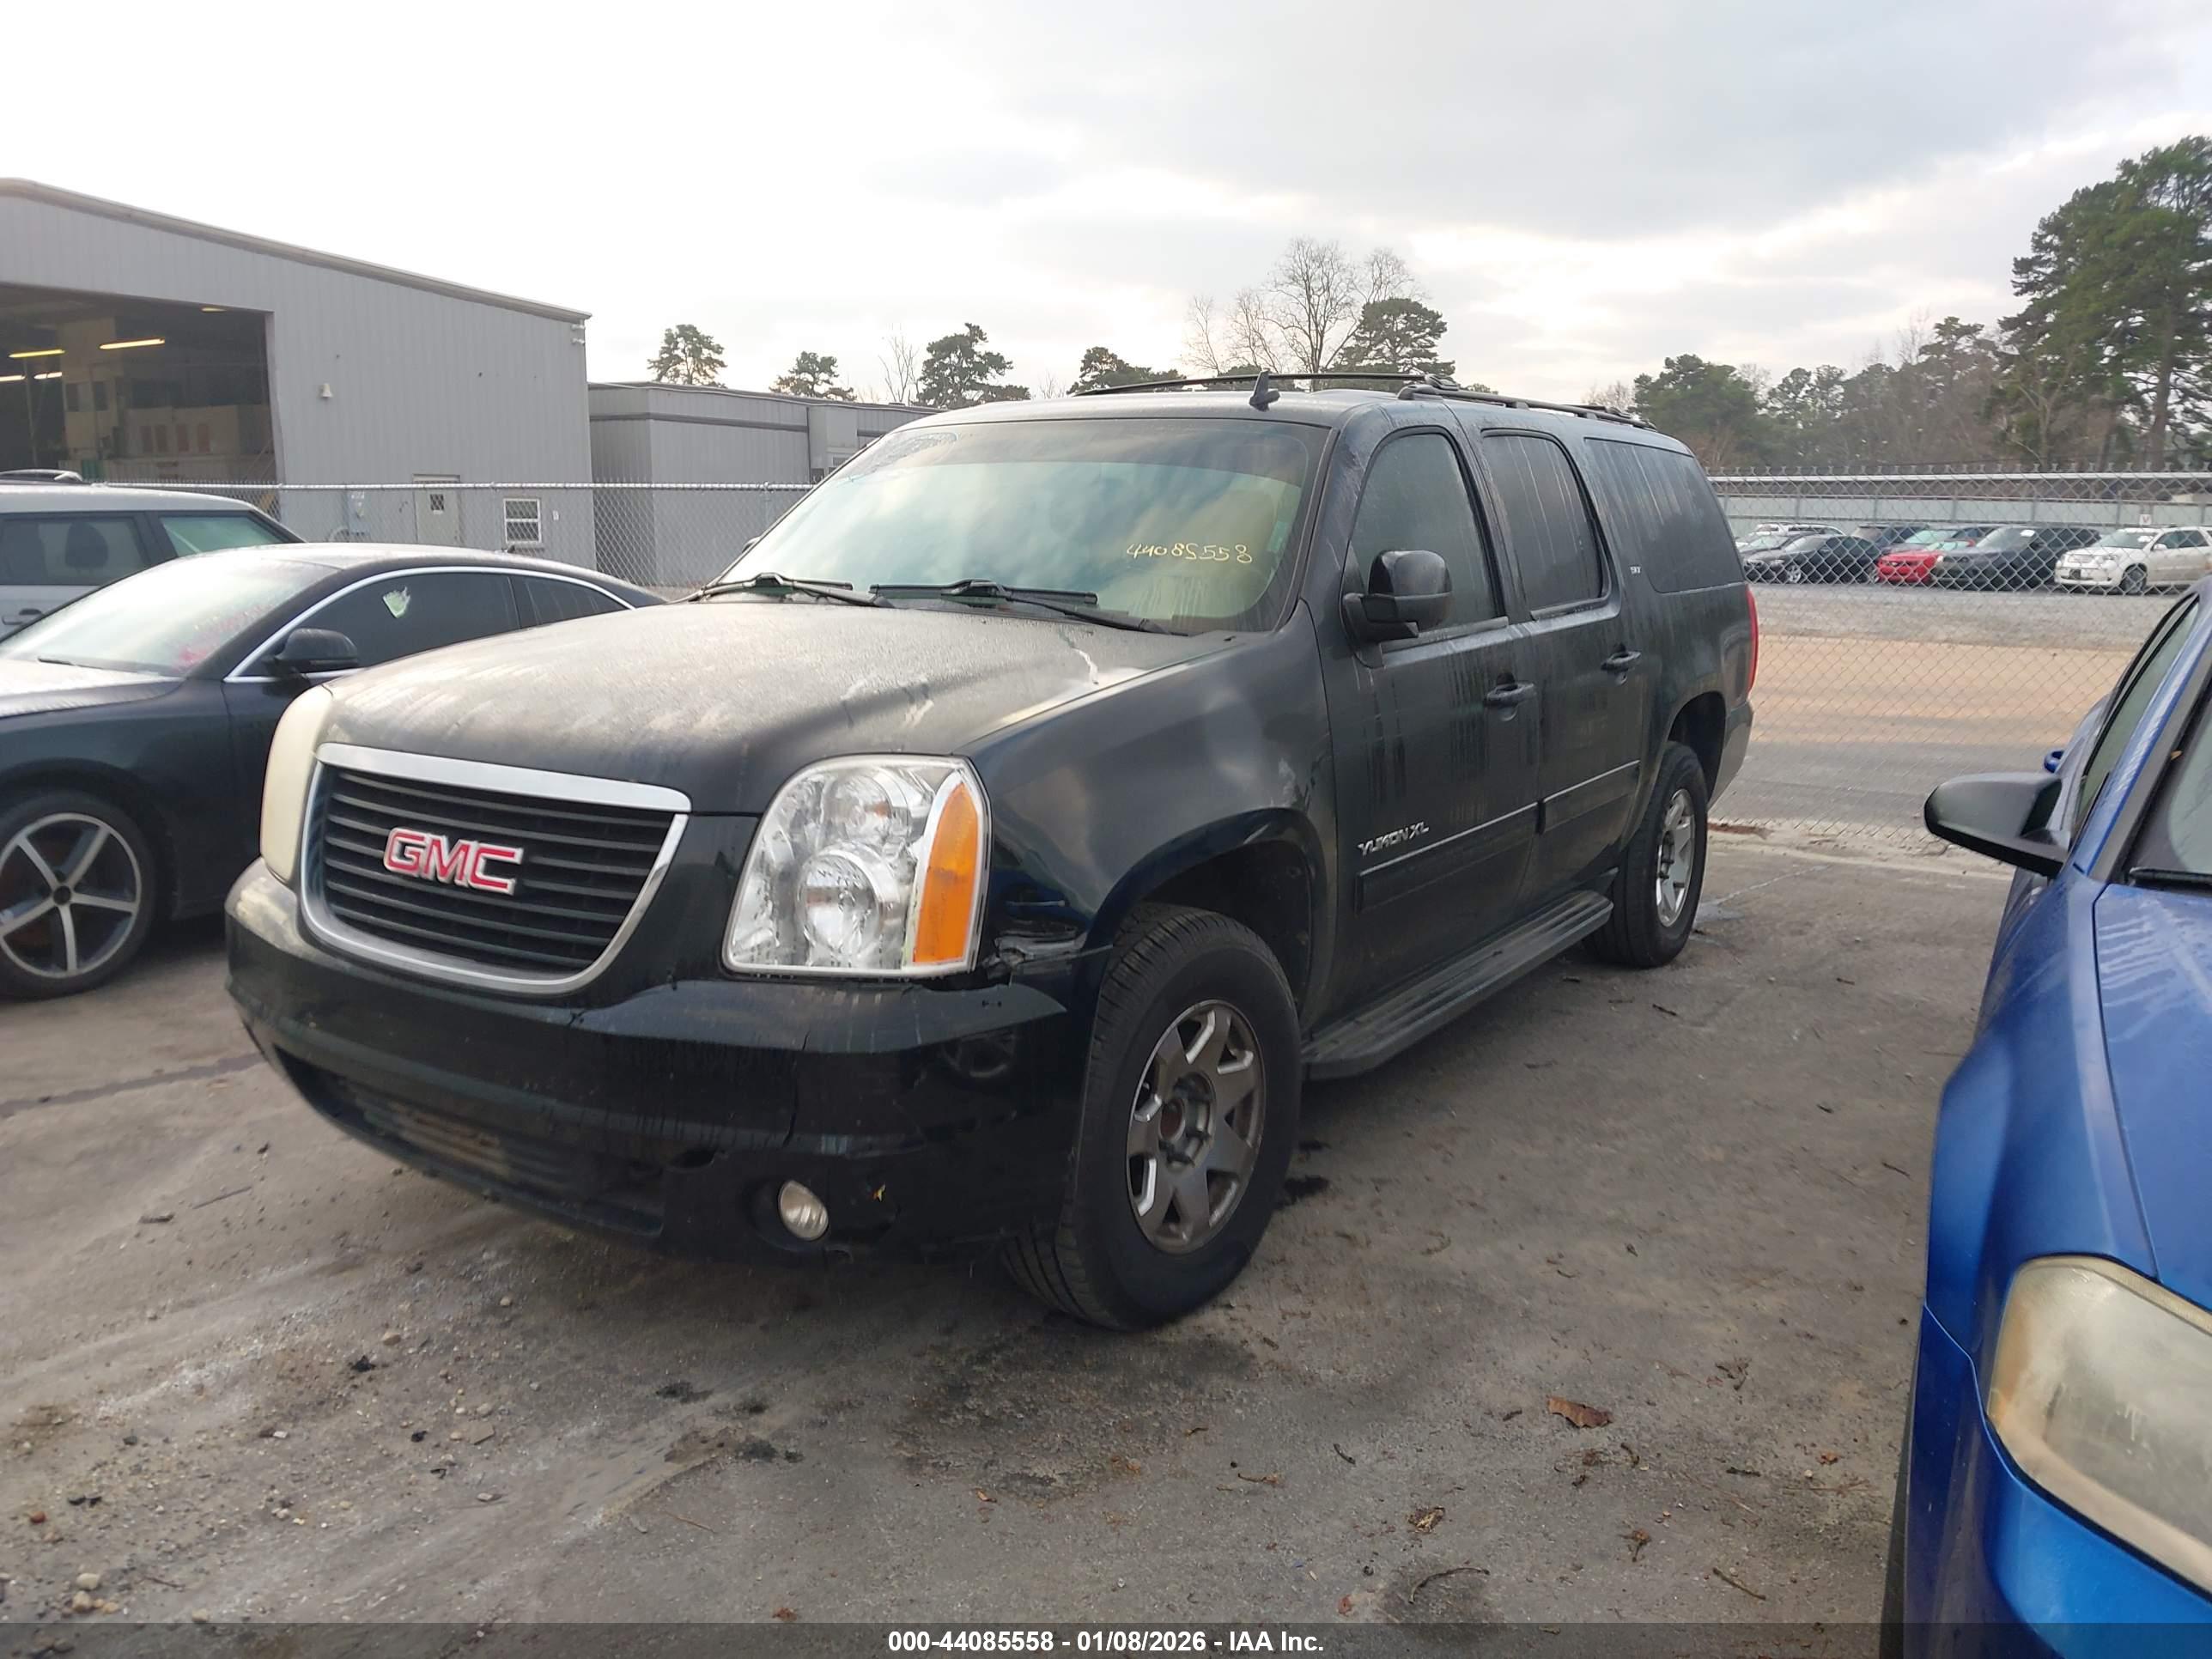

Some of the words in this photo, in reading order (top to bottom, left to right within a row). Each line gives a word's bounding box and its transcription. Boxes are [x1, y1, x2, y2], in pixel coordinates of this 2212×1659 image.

[1127, 543, 1252, 563] 44085558
[1358, 827, 1409, 856] YUKON
[1409, 822, 1430, 840] XL
[383, 827, 524, 896] GMC
